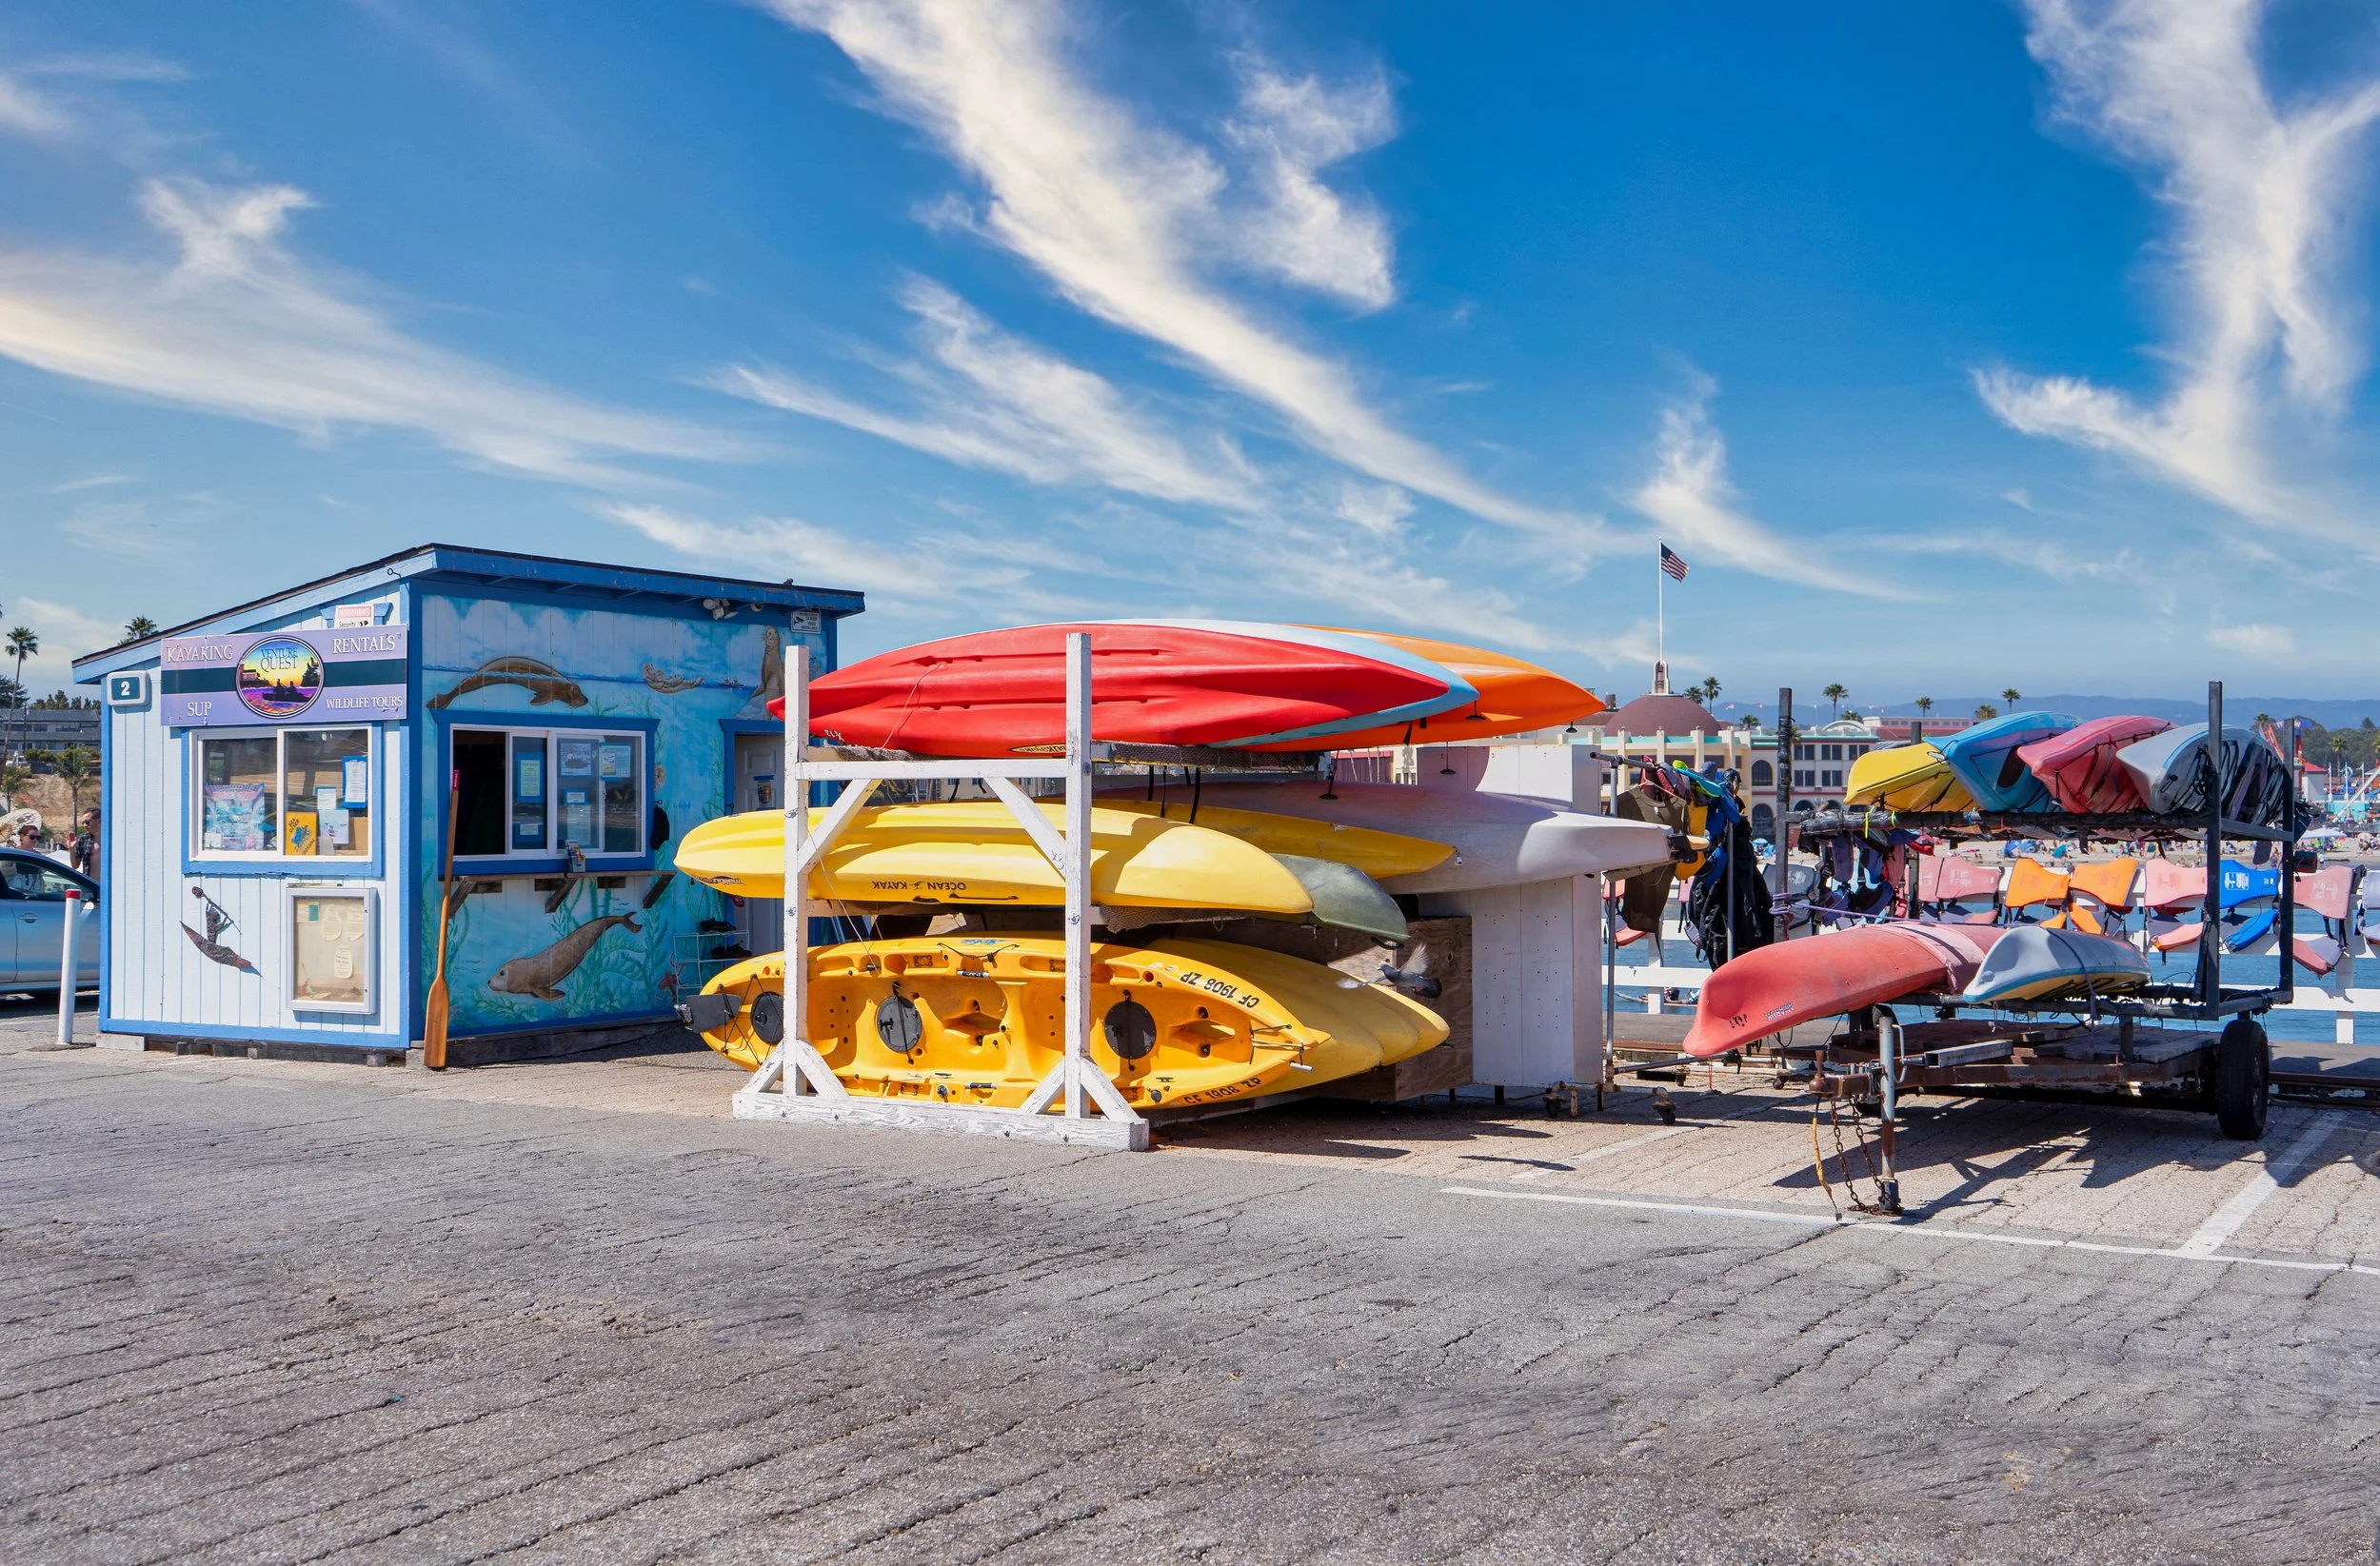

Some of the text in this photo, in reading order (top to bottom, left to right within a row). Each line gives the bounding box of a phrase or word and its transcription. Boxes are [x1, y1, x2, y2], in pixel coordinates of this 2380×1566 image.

[167, 635, 396, 663] KAYAKING RENTALS
[261, 647, 298, 658] VENTURE
[261, 656, 298, 673] QUEST
[121, 681, 130, 696] 2
[187, 702, 212, 717] SUP
[326, 695, 403, 709] WILDLIFE TOURS
[872, 881, 967, 891] OCEAN KAYAK
[1180, 971, 1260, 1008] CF 1908 ZP
[1183, 1077, 1262, 1104] CF 1908 ZP
